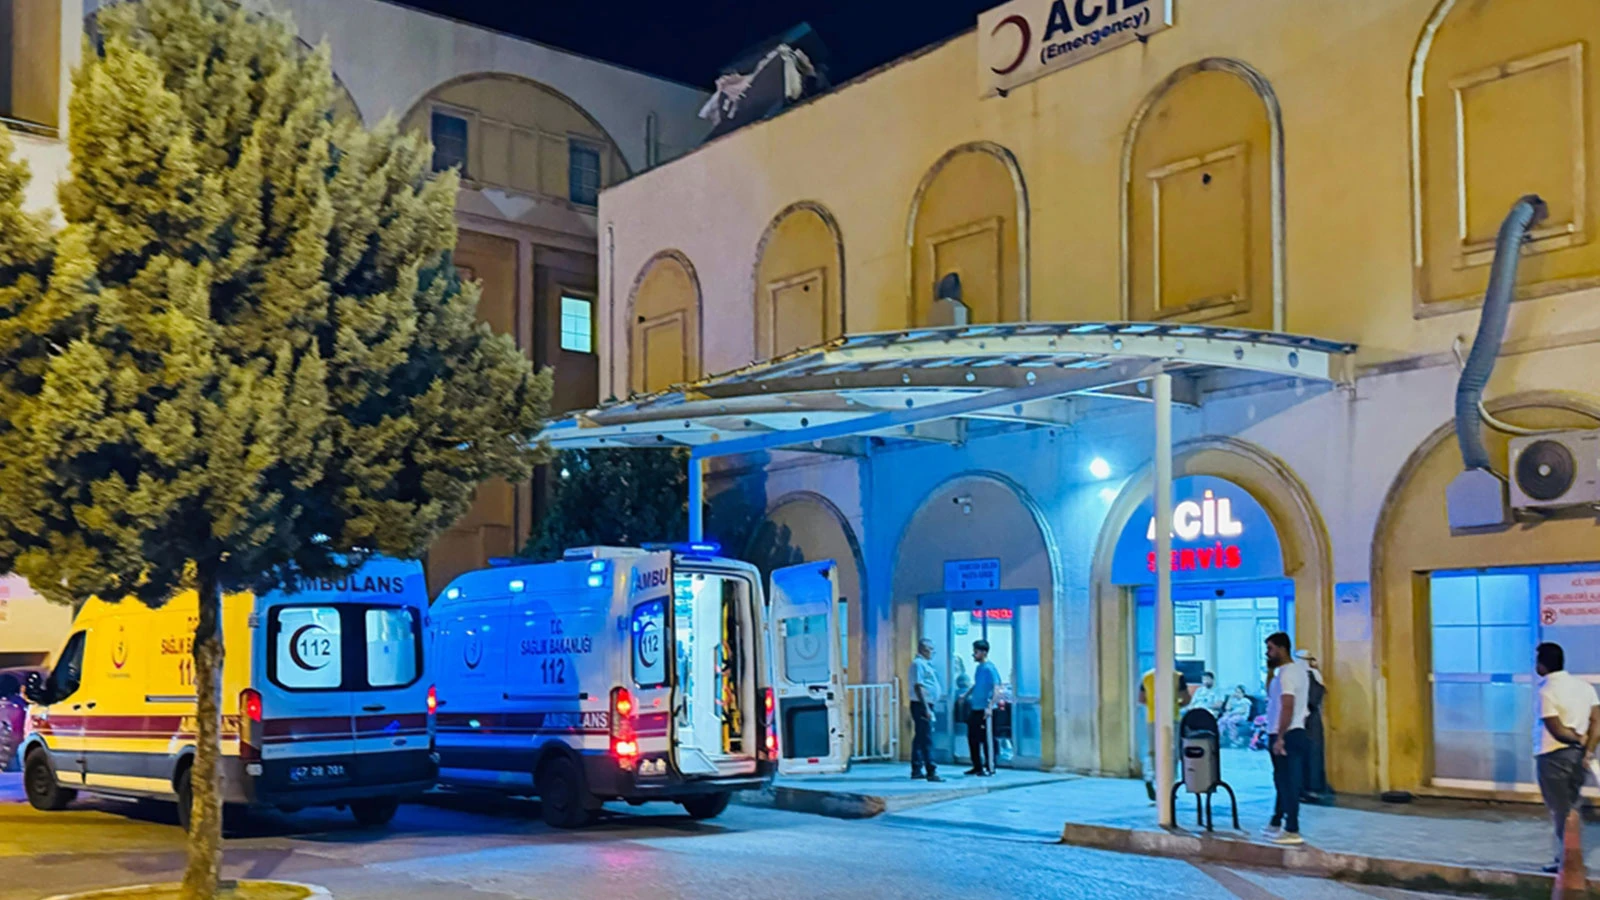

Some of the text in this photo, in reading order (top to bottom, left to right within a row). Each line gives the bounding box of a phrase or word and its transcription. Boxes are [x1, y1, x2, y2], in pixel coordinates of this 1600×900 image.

[1040, 6, 1150, 65] (Emergency)
[300, 576, 404, 593] MBULANS
[300, 639, 331, 656] 112
[642, 634, 659, 655] 112
[178, 658, 197, 686] 11
[541, 658, 566, 685] 112
